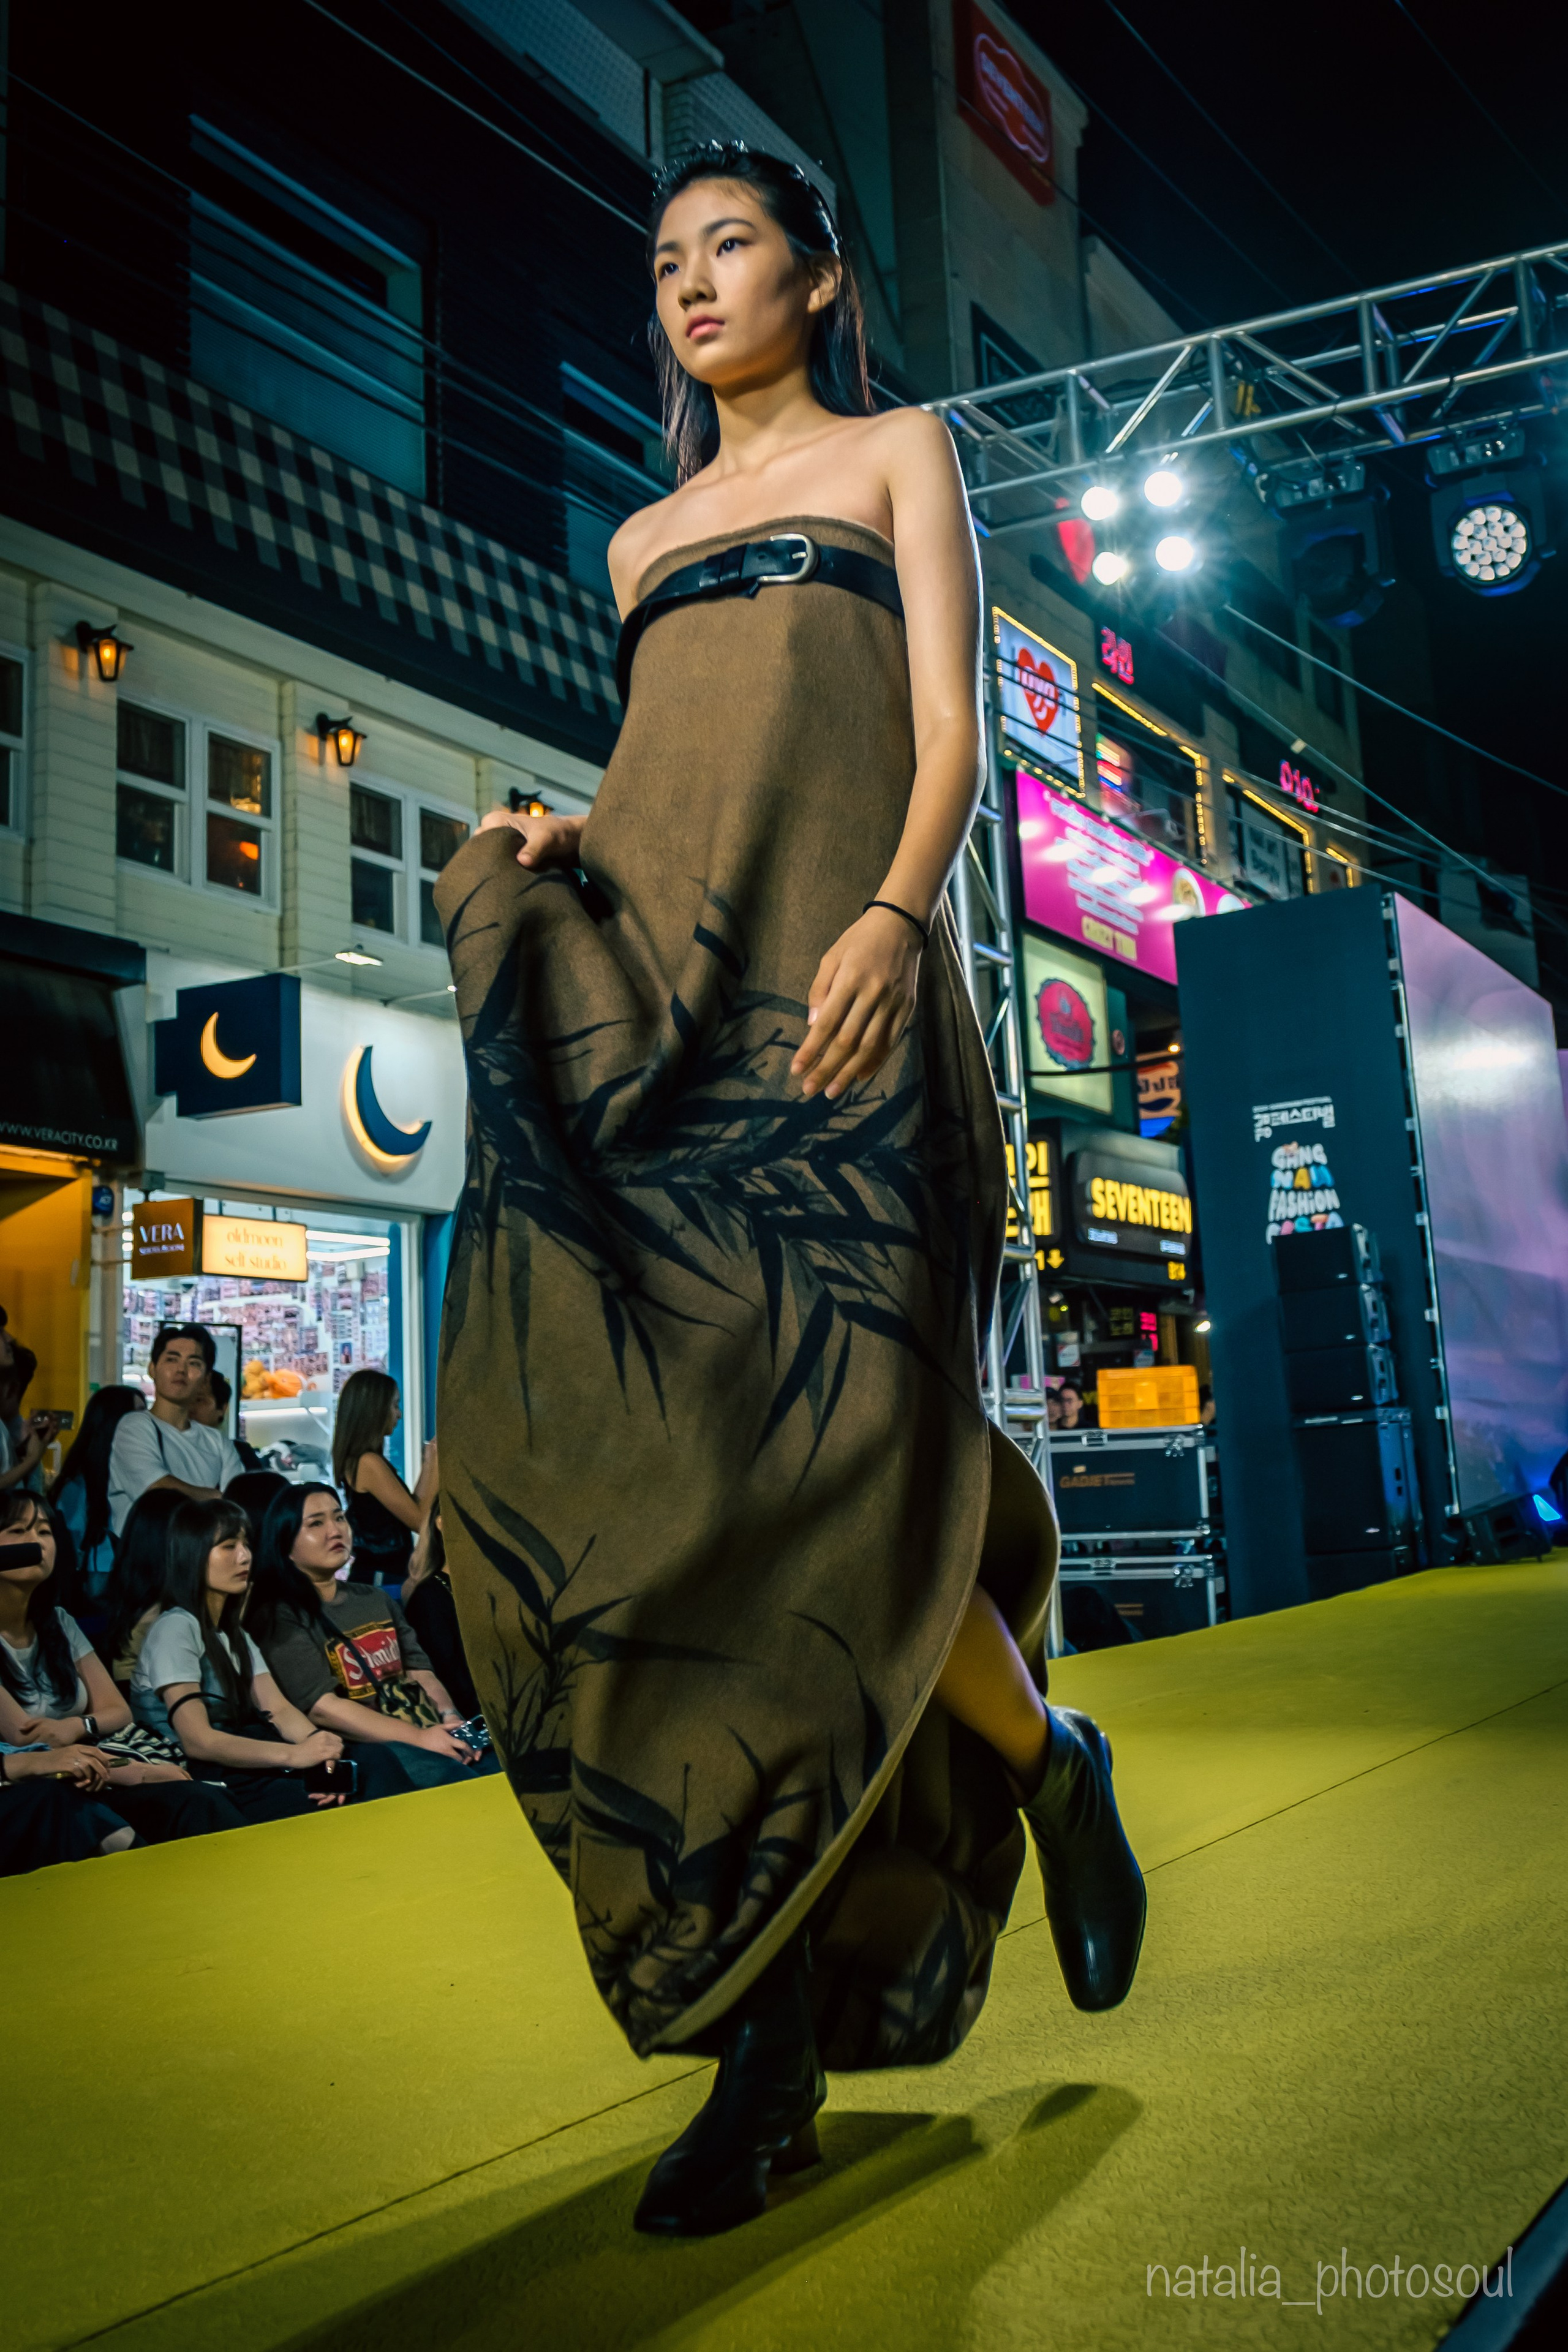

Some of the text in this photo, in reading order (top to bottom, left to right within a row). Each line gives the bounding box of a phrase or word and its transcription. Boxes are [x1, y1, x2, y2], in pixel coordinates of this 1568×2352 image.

[1270, 1164, 1335, 1190] NAM
[1091, 1177, 1192, 1234] SEVENTEEN
[139, 1223, 184, 1243] VERA
[249, 1255, 287, 1271] studio
